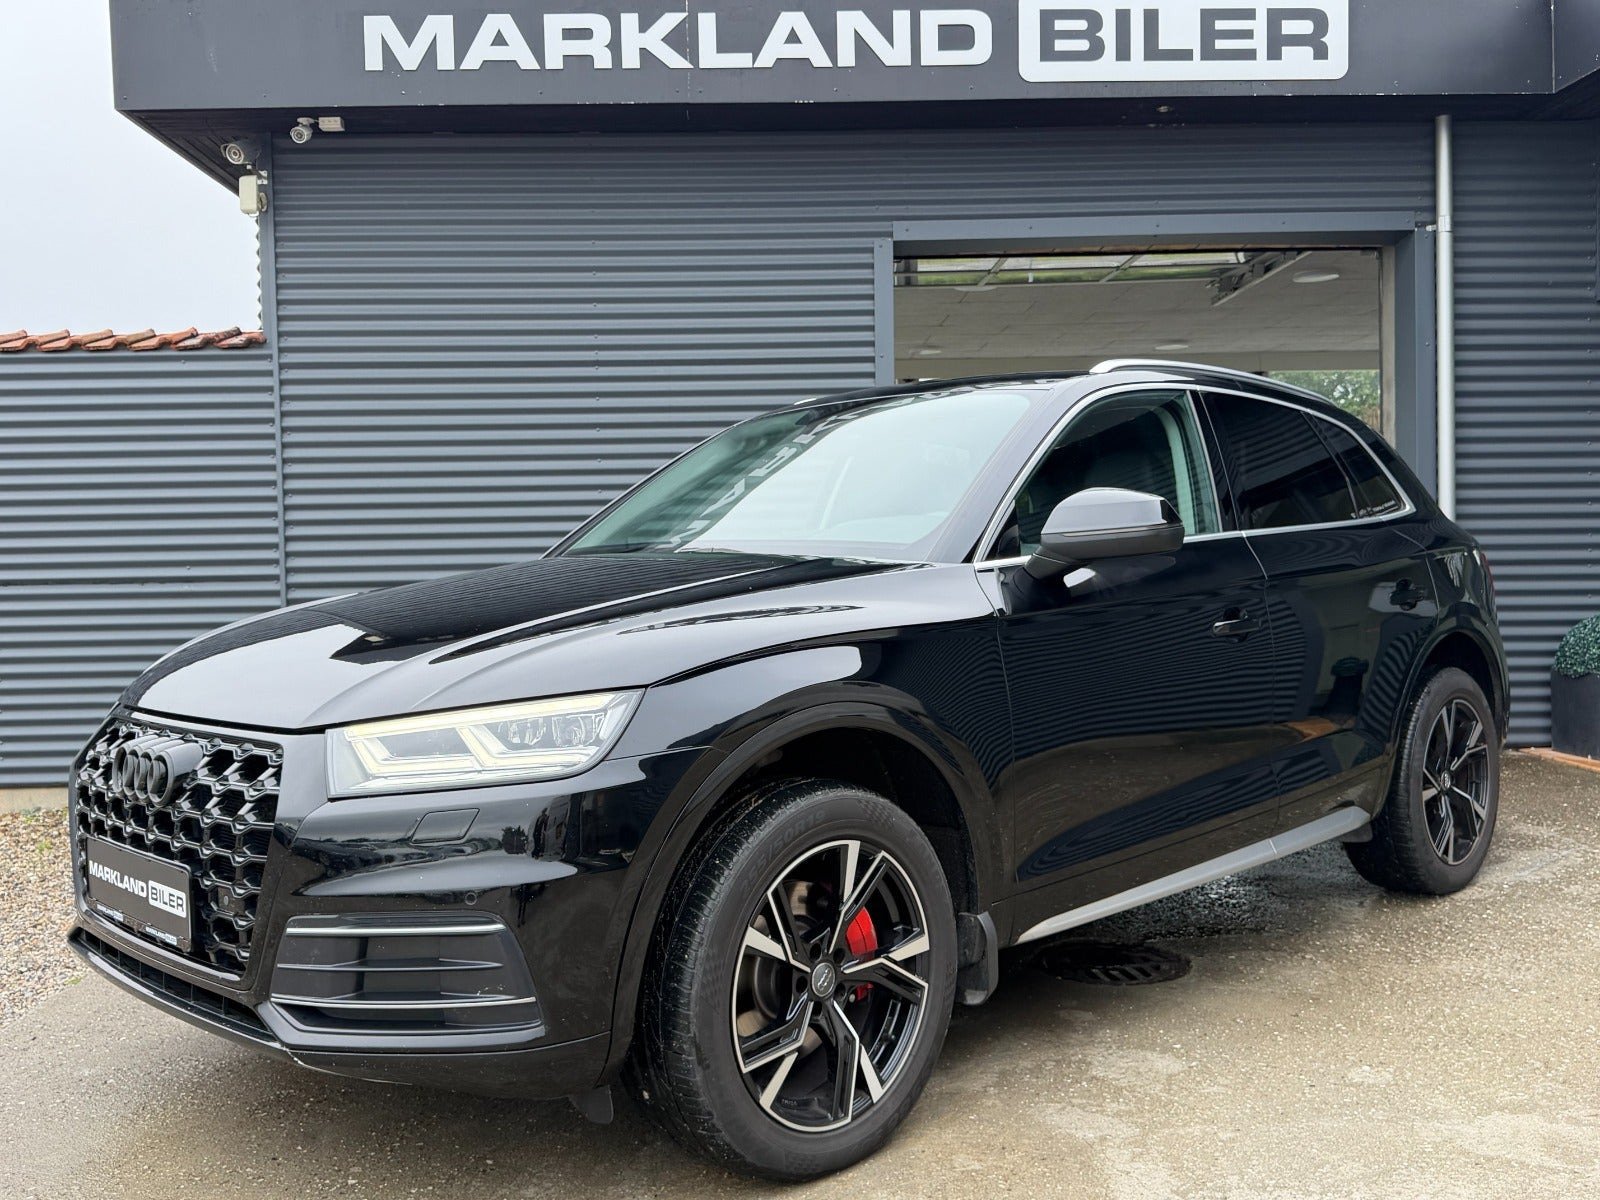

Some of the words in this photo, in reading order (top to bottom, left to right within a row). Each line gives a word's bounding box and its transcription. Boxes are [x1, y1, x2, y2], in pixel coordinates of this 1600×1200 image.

[364, 11, 993, 72] MARKLAND
[1039, 7, 1330, 62] BILER
[88, 860, 147, 898] MARKLAND
[150, 886, 185, 912] BILER
